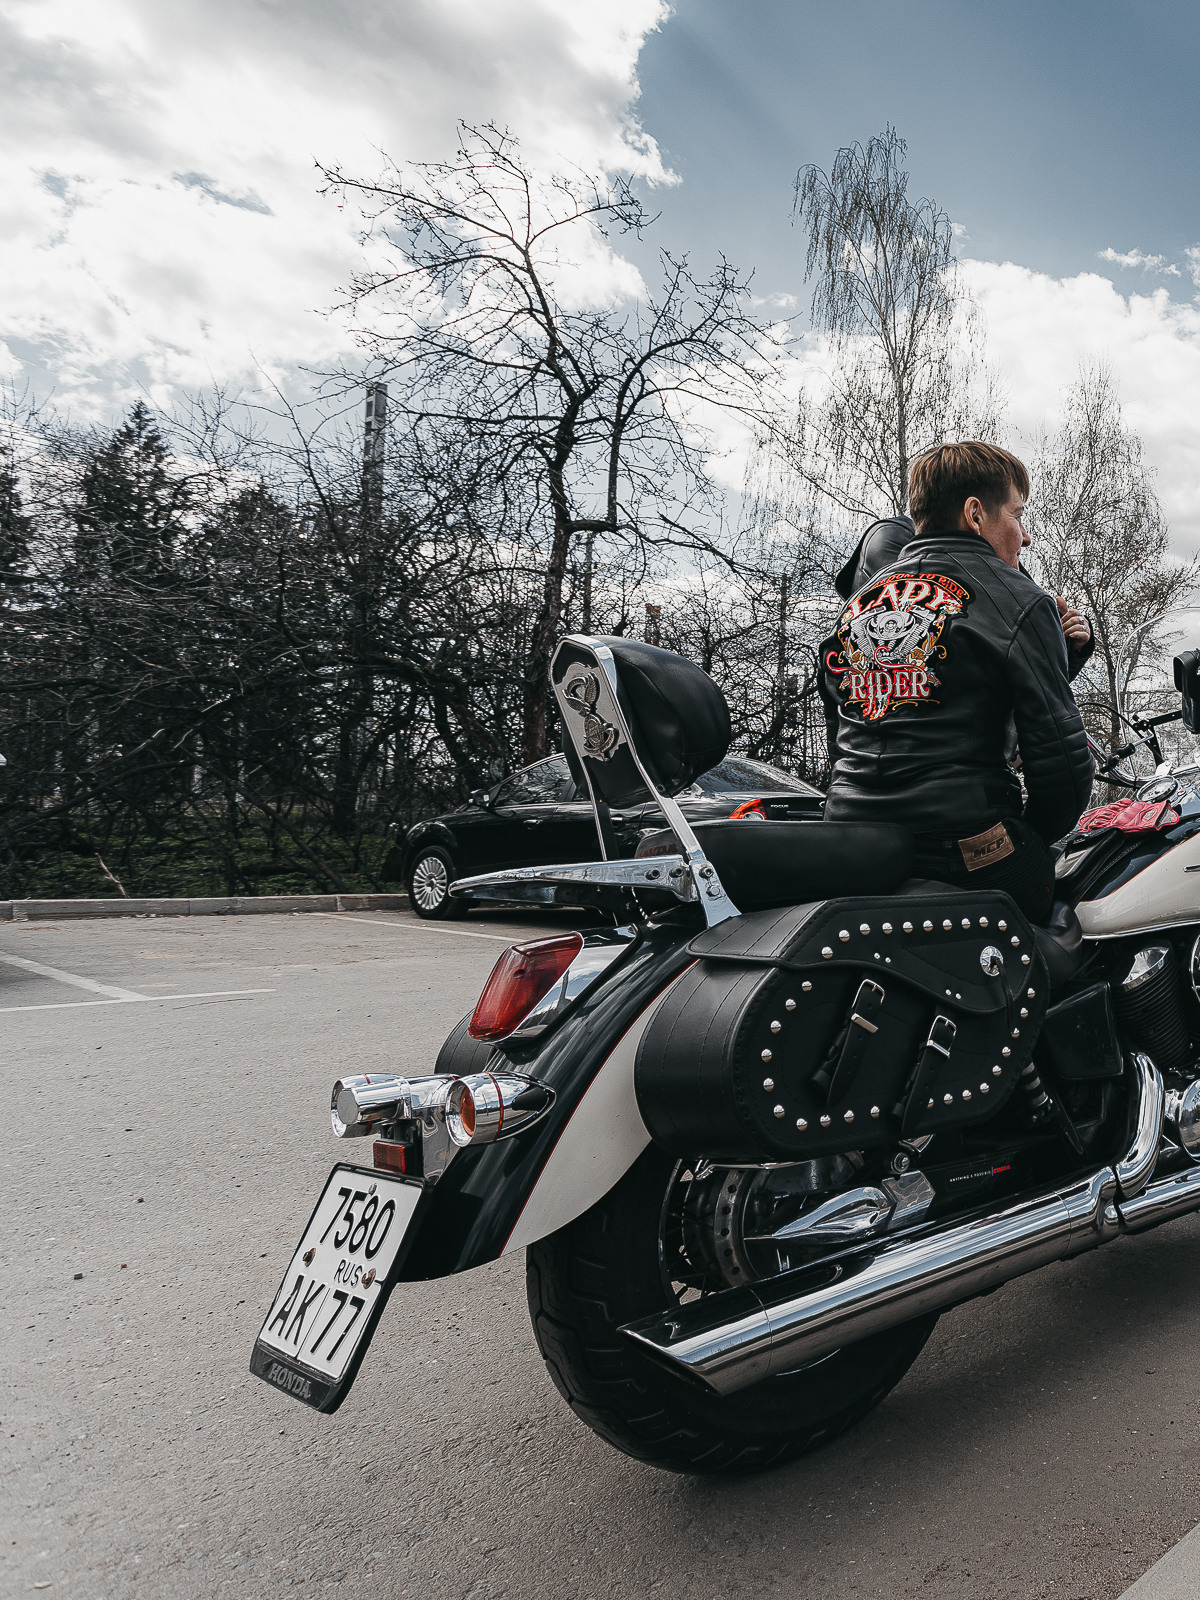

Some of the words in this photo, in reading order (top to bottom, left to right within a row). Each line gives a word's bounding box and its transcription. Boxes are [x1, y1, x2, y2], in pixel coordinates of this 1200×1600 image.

[848, 579, 963, 620] LADY
[938, 575, 965, 598] RIDE
[849, 669, 931, 706] RIDER
[319, 1186, 397, 1260] 7580
[333, 1259, 363, 1287] RUS
[268, 1275, 326, 1346] AK
[310, 1289, 366, 1362] 77
[267, 1362, 312, 1400] HONDA
